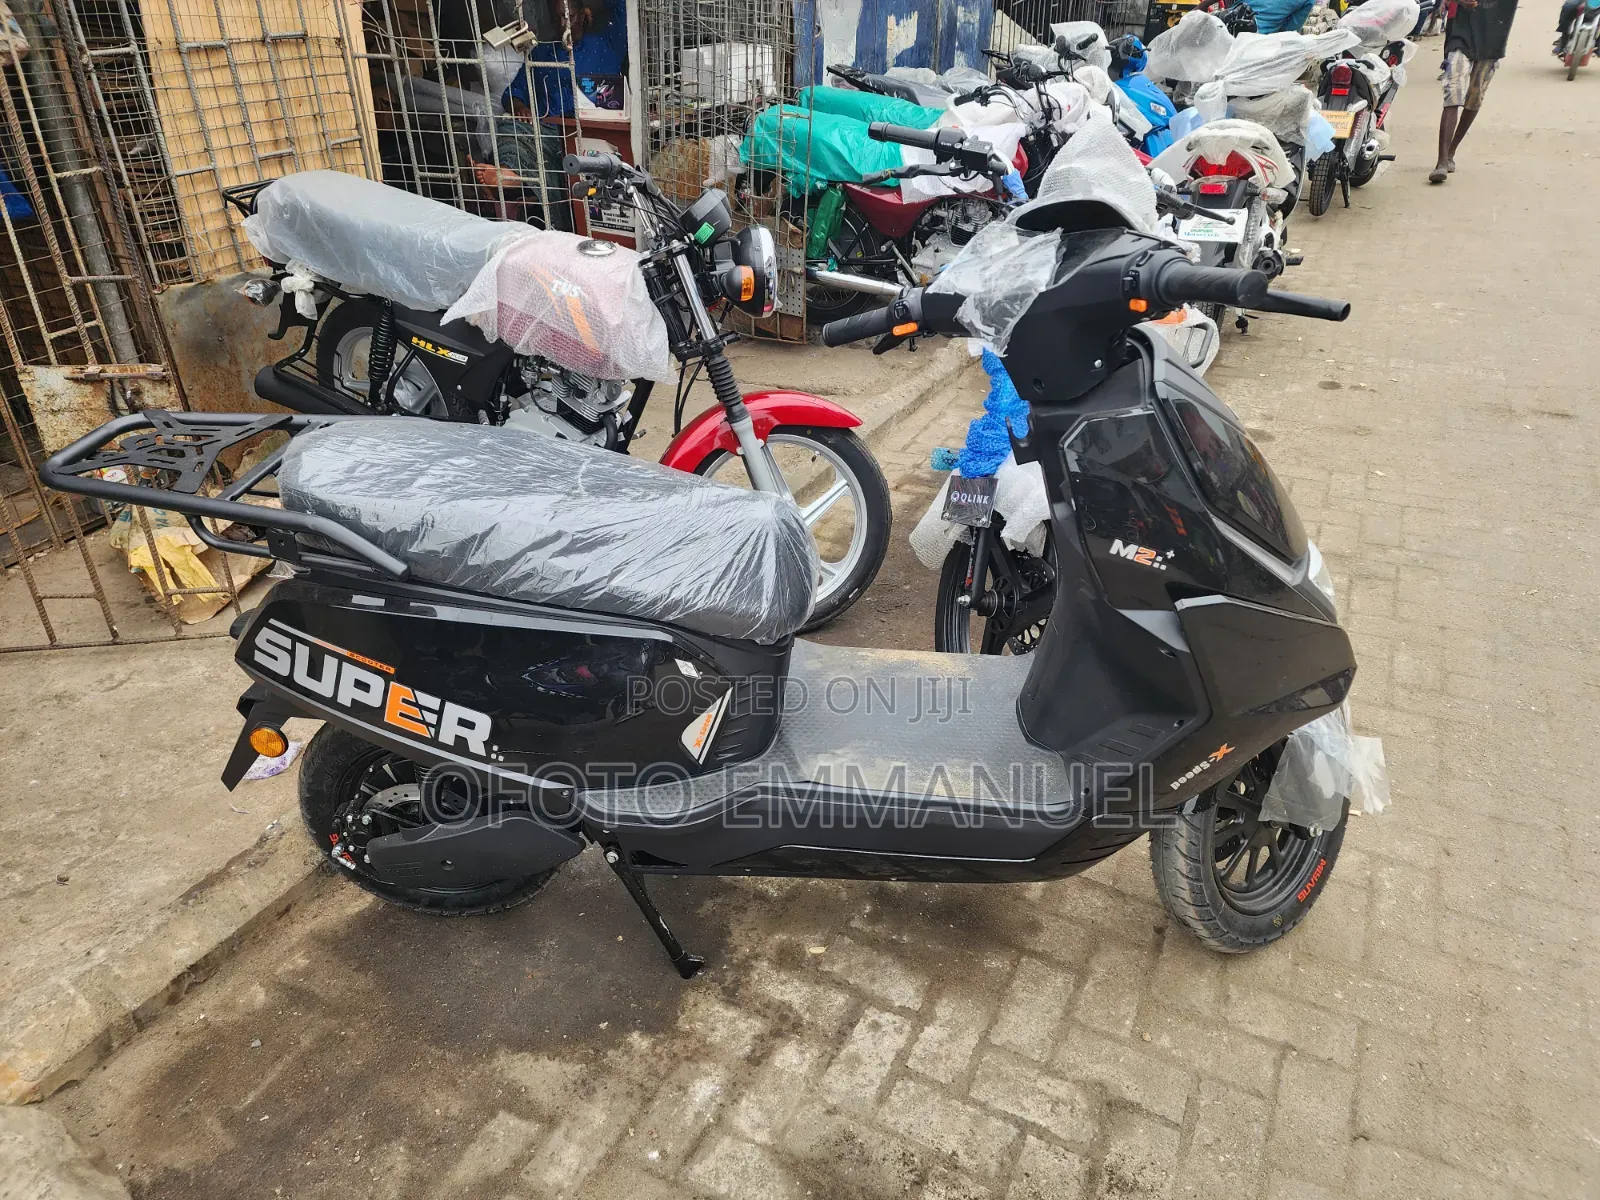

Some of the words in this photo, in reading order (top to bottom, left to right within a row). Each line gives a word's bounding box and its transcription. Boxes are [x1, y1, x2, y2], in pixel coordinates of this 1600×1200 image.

[551, 279, 582, 298] TVS
[411, 336, 451, 357] HLX
[960, 493, 989, 504] QLINK
[348, 652, 392, 672] SCOOTER
[254, 626, 493, 757] SUPER
[1170, 742, 1236, 791] X-Speed
